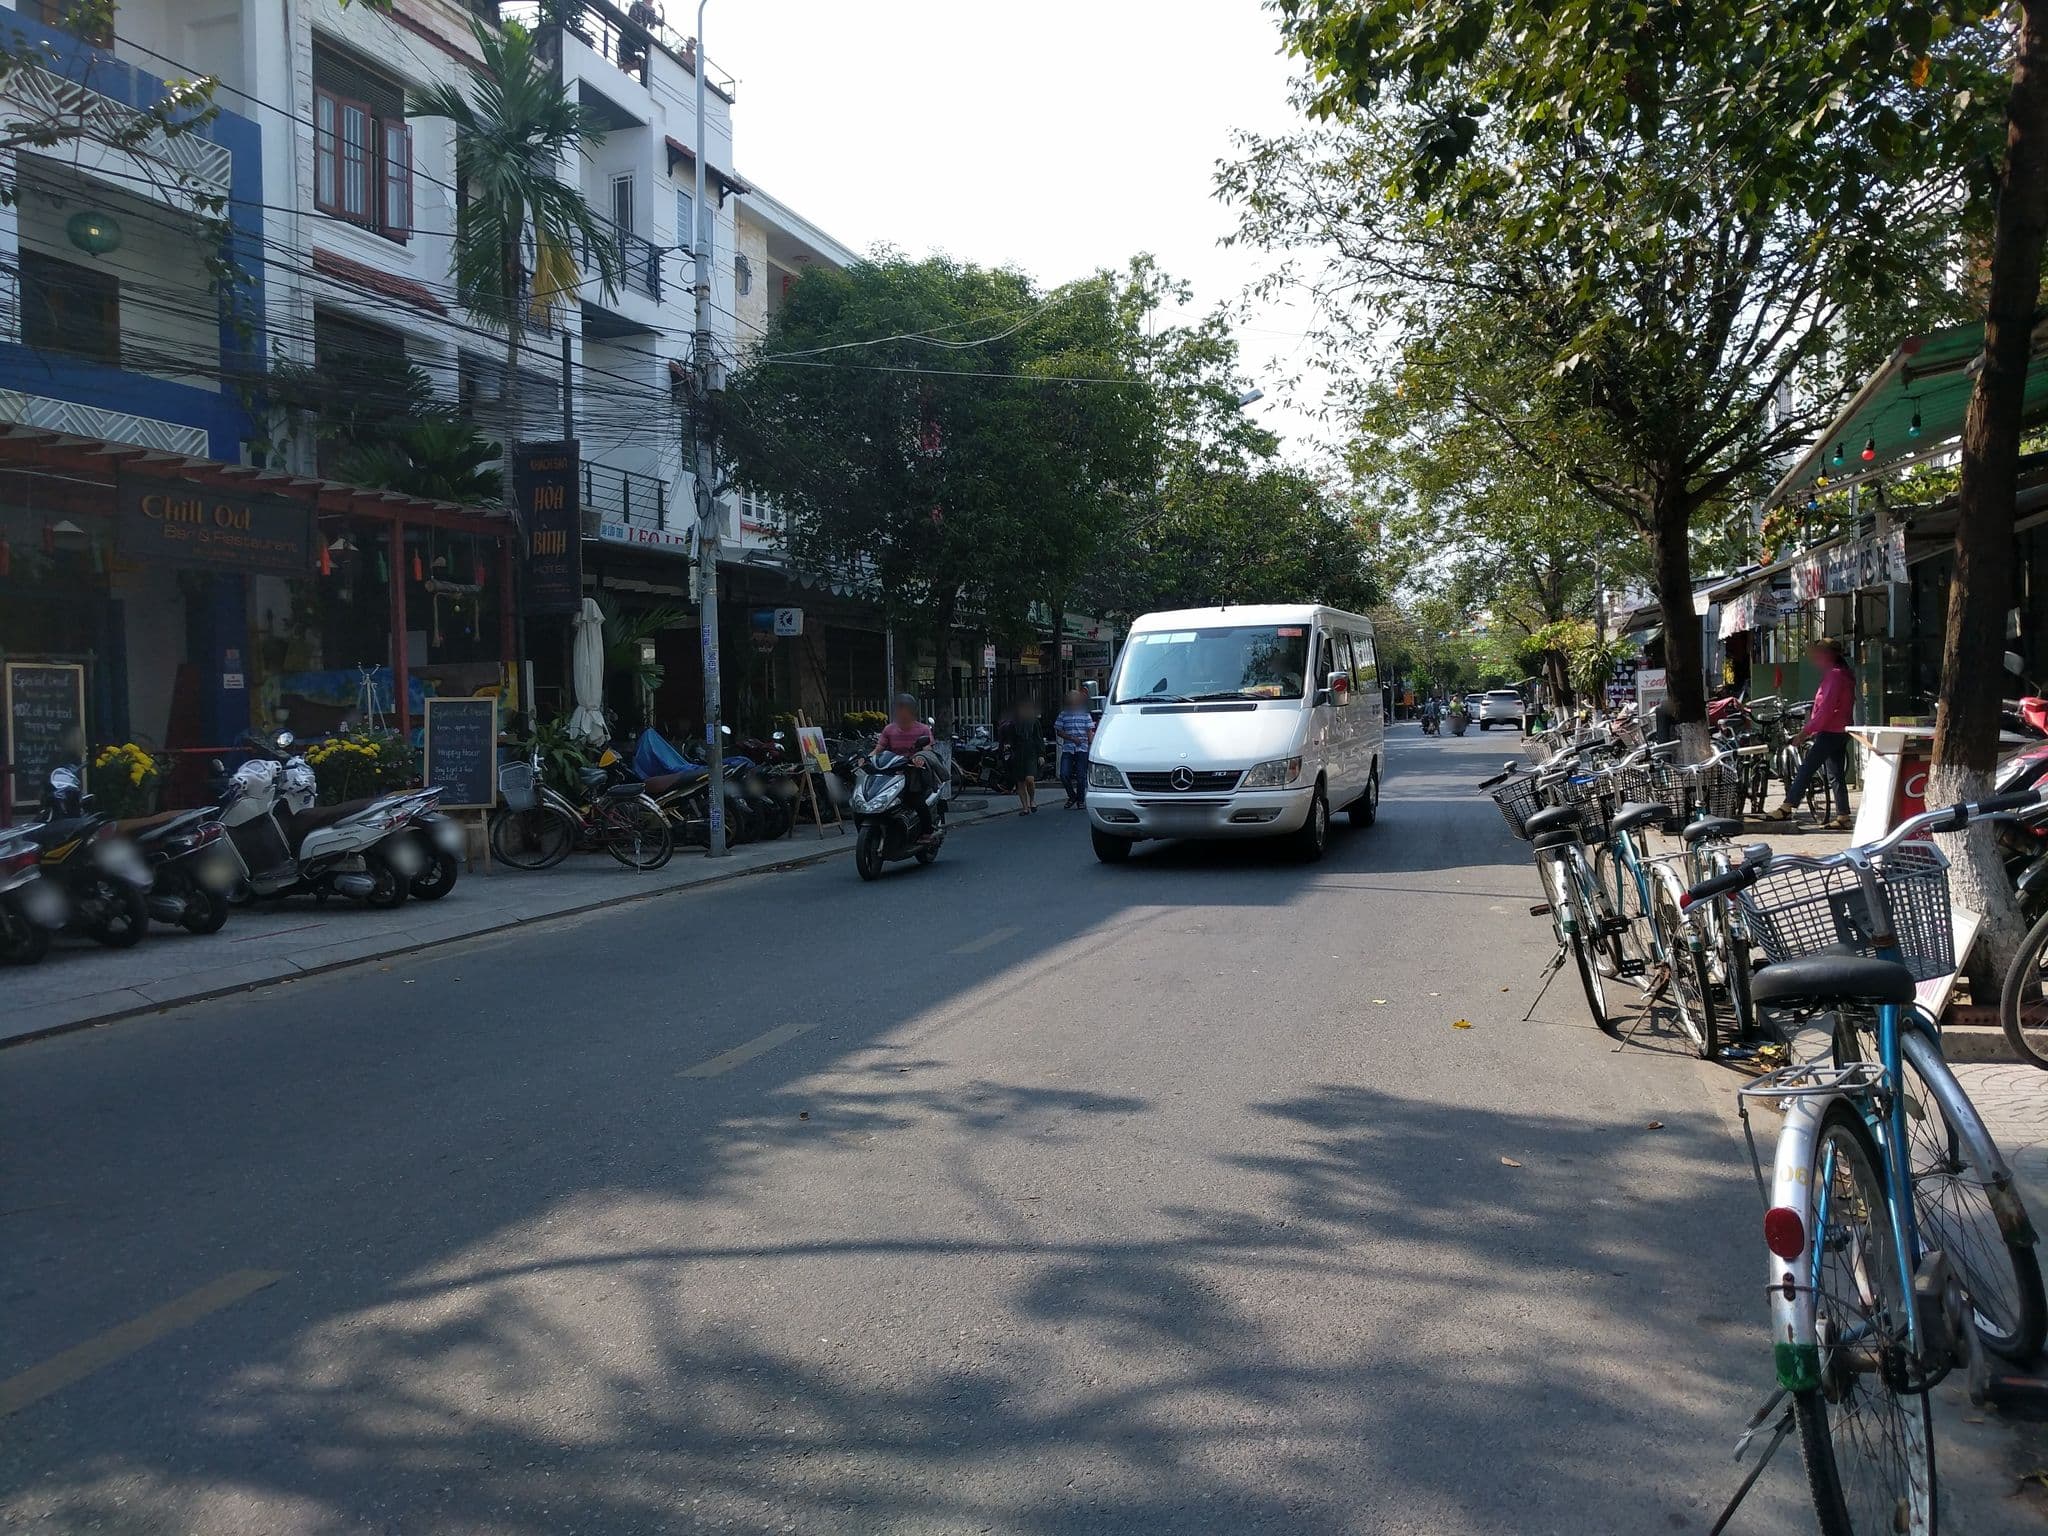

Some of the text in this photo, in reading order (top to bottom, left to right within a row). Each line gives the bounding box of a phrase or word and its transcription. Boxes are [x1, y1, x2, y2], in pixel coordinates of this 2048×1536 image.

[141, 495, 203, 523] Chill
[534, 480, 564, 513] HÒA
[163, 522, 193, 540] Bar
[213, 531, 299, 553] Restaurant
[533, 523, 567, 557] BÌNH
